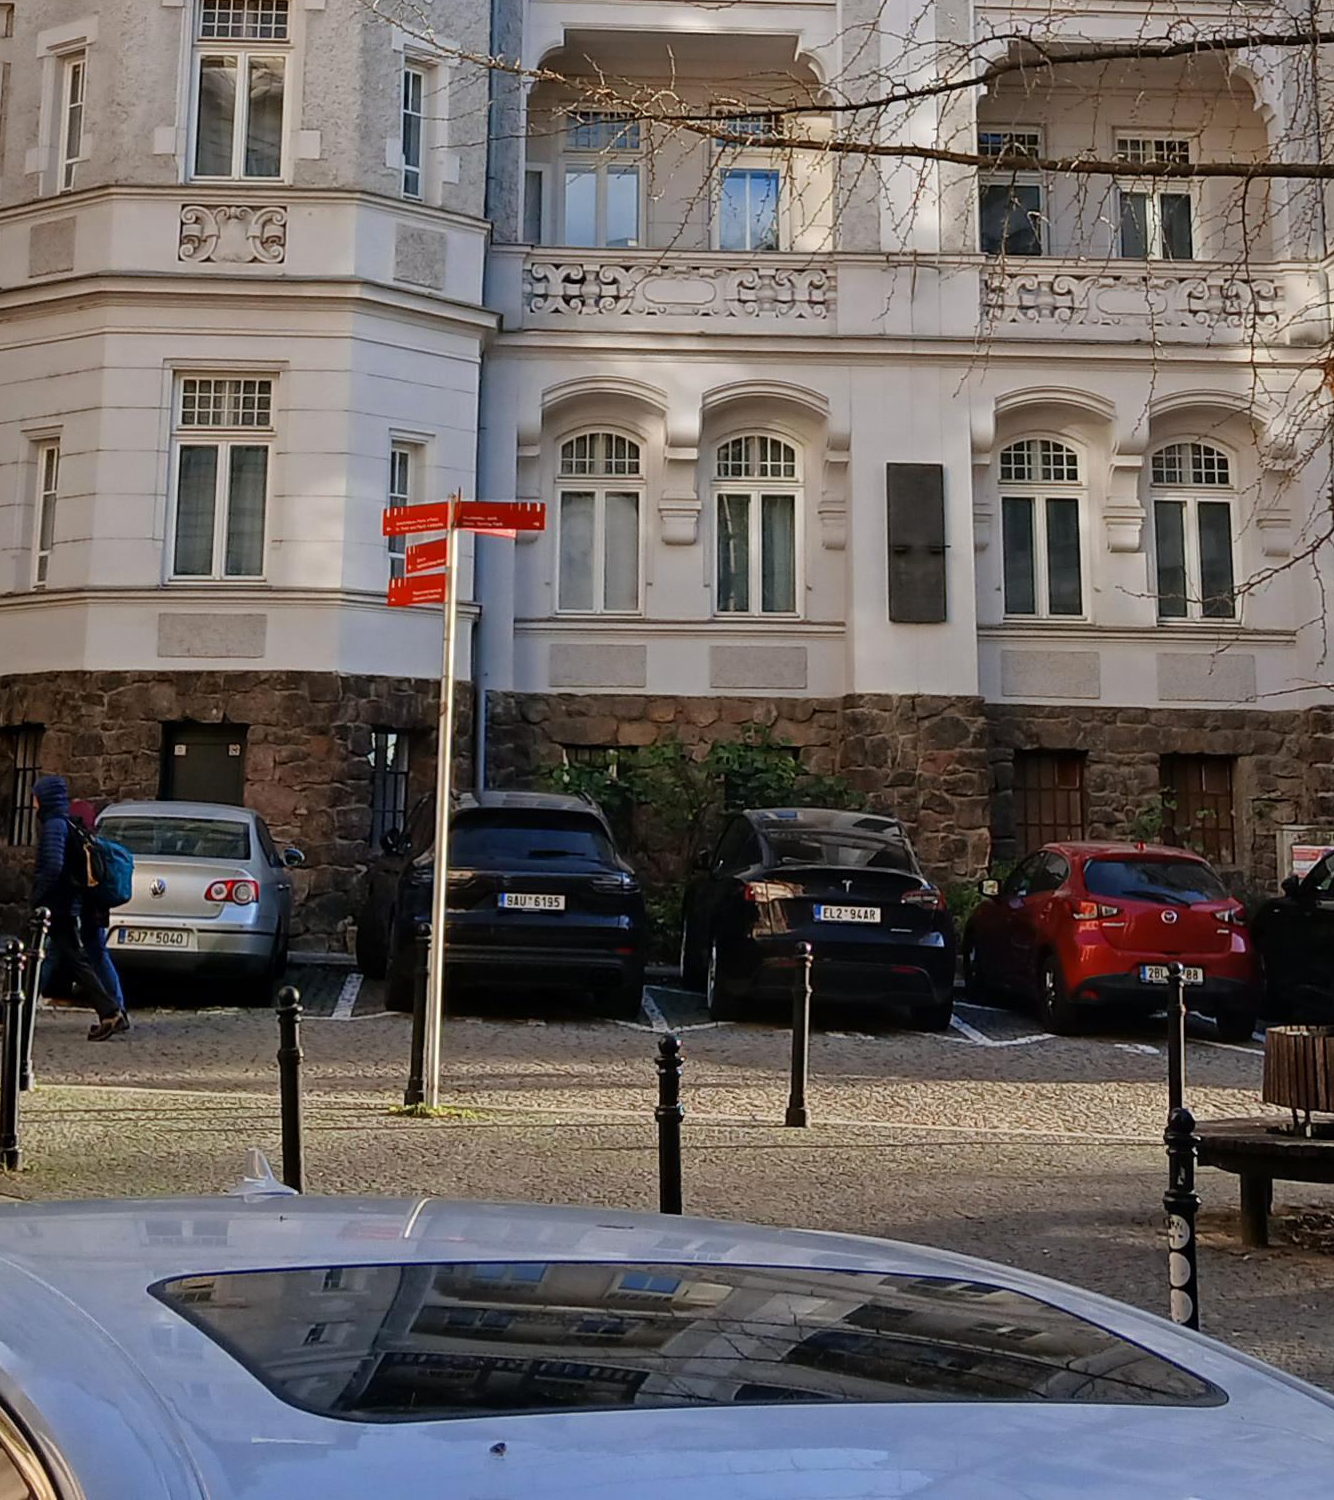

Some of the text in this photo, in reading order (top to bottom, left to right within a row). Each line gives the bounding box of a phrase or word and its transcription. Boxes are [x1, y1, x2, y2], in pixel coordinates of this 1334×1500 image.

[507, 895, 560, 908] 9AU 6195
[823, 907, 876, 920] EL2 94AR
[127, 931, 183, 944] 5J7 5040
